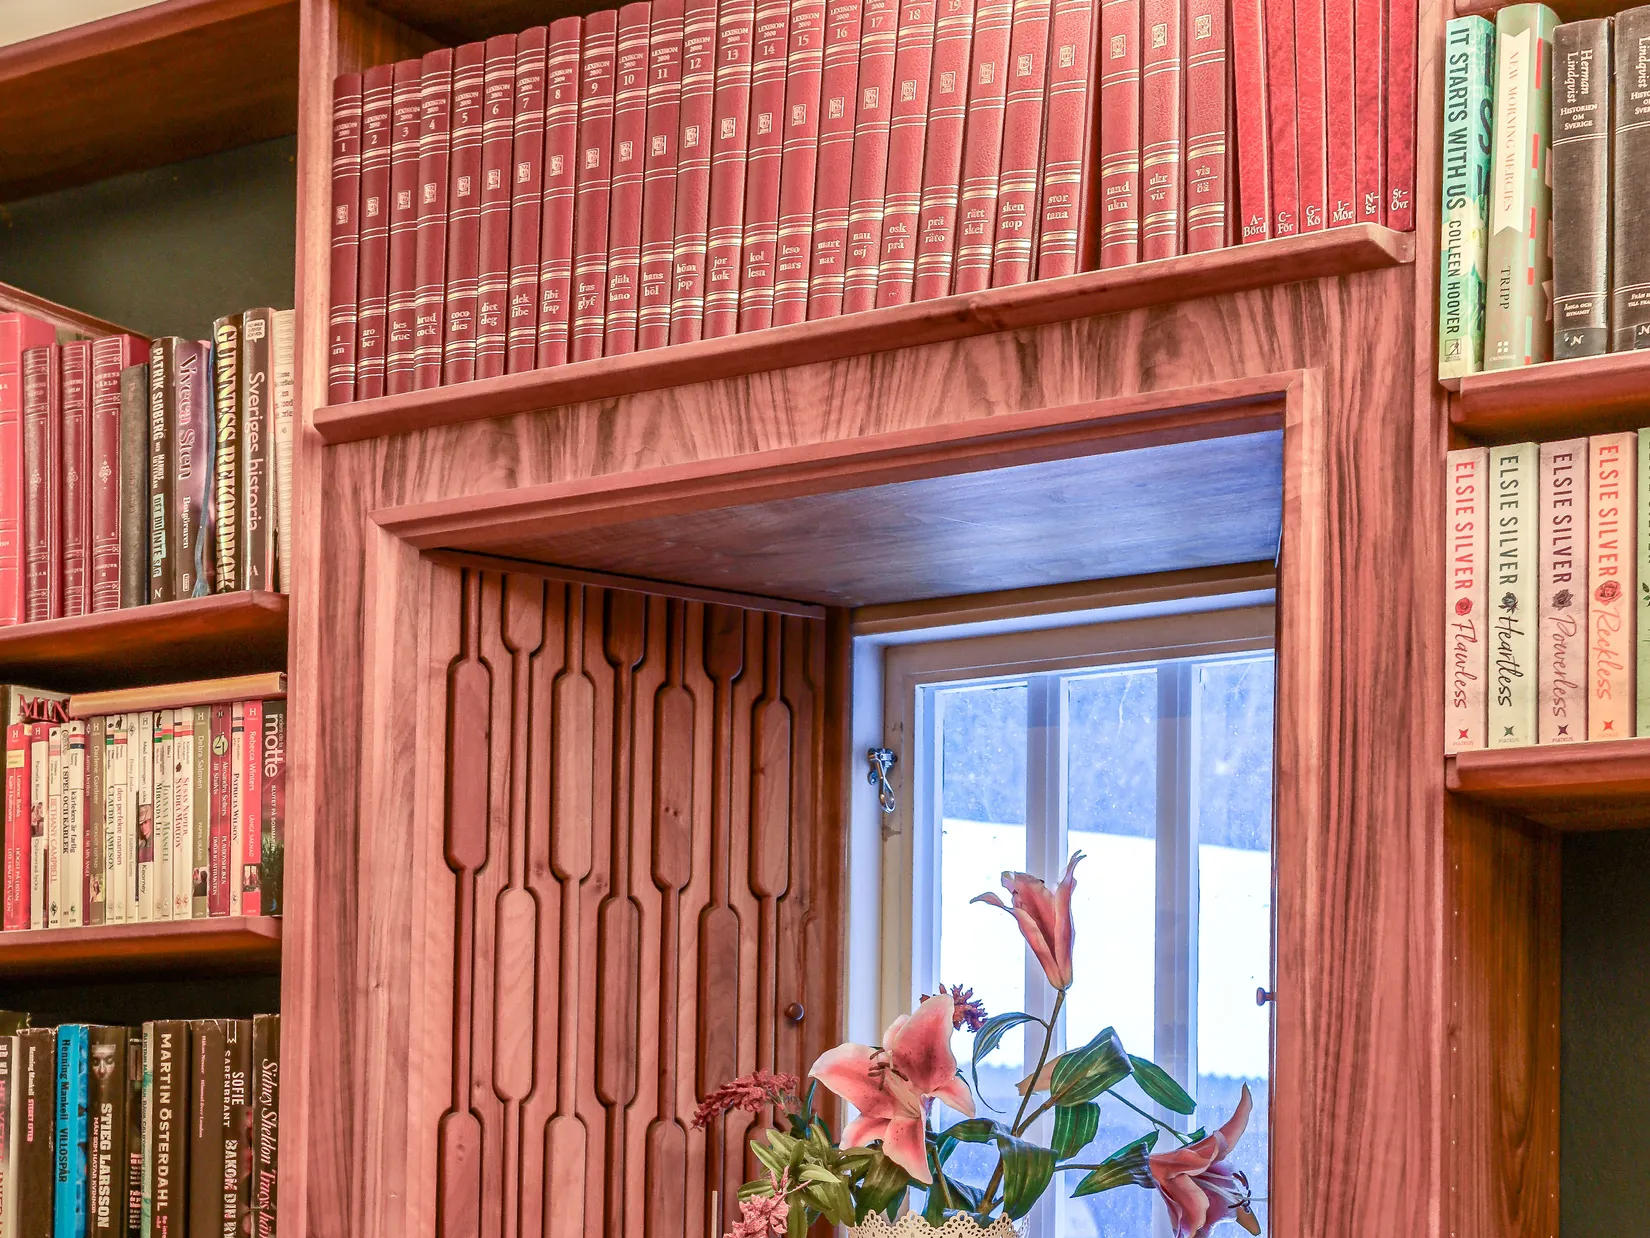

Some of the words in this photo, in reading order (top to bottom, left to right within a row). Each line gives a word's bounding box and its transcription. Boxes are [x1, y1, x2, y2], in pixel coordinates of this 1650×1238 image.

[909, 9, 920, 20] 18
[871, 17, 883, 28] 17
[836, 27, 848, 38] 16
[1450, 26, 1469, 45] IT
[798, 35, 809, 46] 15
[727, 50, 739, 60] 13
[763, 45, 775, 55] 14
[690, 58, 701, 69] 12
[1508, 51, 1519, 80] NEW
[1636, 36, 1650, 88] Lindqvist
[657, 69, 668, 79] 11
[1564, 51, 1580, 103] Lindqvist
[1581, 49, 1593, 95] Herman
[624, 75, 634, 85] 10
[1448, 50, 1469, 121] STARTS
[555, 89, 560, 99] 8
[592, 83, 598, 93] 9
[493, 105, 499, 115] 6
[523, 98, 529, 108] 7
[1560, 104, 1597, 116] HISTORIEN
[462, 113, 468, 123] 5
[1506, 84, 1517, 155] MORNING
[1572, 113, 1585, 121] OM
[429, 120, 435, 129] 4
[1564, 120, 1593, 130] SVERIGE
[371, 135, 377, 144] 2
[402, 128, 408, 137] 3
[1447, 127, 1468, 180] WITH
[1195, 165, 1211, 176] vis
[1150, 173, 1168, 185] ukr
[1504, 159, 1515, 213] MERCIES
[1106, 181, 1130, 195] tand
[1048, 193, 1068, 204] stor
[1151, 190, 1165, 201] vir
[1446, 183, 1465, 211] US
[1002, 202, 1024, 213] sken
[1391, 197, 1409, 211] Övr
[1307, 216, 1321, 226] Kö
[1333, 209, 1354, 223] Mör
[889, 222, 907, 233] osk
[964, 223, 984, 235] skel
[1001, 219, 1023, 230] stop
[1243, 223, 1267, 237] Börd
[1277, 222, 1294, 234] För
[853, 232, 872, 241] nau
[782, 245, 800, 255] leso
[853, 246, 866, 258] osj
[1447, 220, 1461, 278] COLLEEN
[714, 256, 728, 268] jor
[750, 251, 764, 262] kol
[779, 261, 801, 271] mars
[644, 272, 664, 281] hans
[712, 271, 730, 281] kok
[678, 279, 693, 291] jop
[1500, 265, 1511, 310] TRIPP
[544, 290, 559, 300] fibi
[609, 292, 630, 302] hano
[543, 302, 560, 314] frap
[578, 296, 597, 310] glyf
[1445, 281, 1460, 336] HOOVER
[417, 312, 437, 325] brud
[451, 309, 470, 319] coco
[362, 328, 375, 337] aro
[417, 327, 436, 337] cock
[452, 322, 468, 332] dies
[362, 339, 375, 348] ber
[152, 347, 164, 390] PATRIK
[177, 353, 197, 426] Viveca
[216, 325, 238, 441] GUINNESS
[151, 392, 165, 440] SJÖBERG
[245, 372, 265, 452] Sveriges
[178, 429, 195, 480] Sten
[1599, 445, 1619, 501] ELSIE
[1500, 455, 1519, 511] ELSIE
[1553, 453, 1573, 508] ELSIE
[247, 458, 264, 531] historia
[1455, 461, 1475, 516] ELSIE
[153, 497, 163, 513] DET
[153, 515, 163, 528] DU
[182, 496, 191, 549] Botgöraren
[216, 446, 236, 591] REKORDBOK
[153, 531, 164, 556] INTE
[1552, 515, 1572, 584] SILVER
[1598, 508, 1618, 577] SILVER
[1455, 522, 1473, 590] SILVER
[1499, 517, 1518, 586] SILVER
[1592, 606, 1624, 701] Reckless
[1451, 619, 1478, 709] Flawless
[1494, 615, 1524, 707] Heartless
[1548, 614, 1579, 718] Powerless
[265, 714, 283, 777] motte
[162, 781, 170, 819] JOANNA
[271, 808, 276, 816] PÅ
[71, 824, 77, 832] är
[106, 828, 114, 870] JAMESON
[50, 839, 58, 883] CAMPBELL
[28, 1046, 36, 1072] Henning
[60, 1039, 70, 1080] Henning
[159, 1034, 172, 1104] MARTIN
[232, 1071, 244, 1105] SOFIE
[260, 1058, 278, 1106] Sidney
[60, 1081, 69, 1120] Mankell
[100, 1103, 113, 1151] STIEG
[260, 1107, 278, 1164] Sheldon
[59, 1128, 70, 1183] VILLOSPÅR
[157, 1108, 172, 1211] ÖSTERDAHL
[224, 1140, 237, 1190] BAKOM
[98, 1154, 111, 1228] LARSSON
[258, 1169, 277, 1210] Tracys
[224, 1193, 236, 1219] DIN
